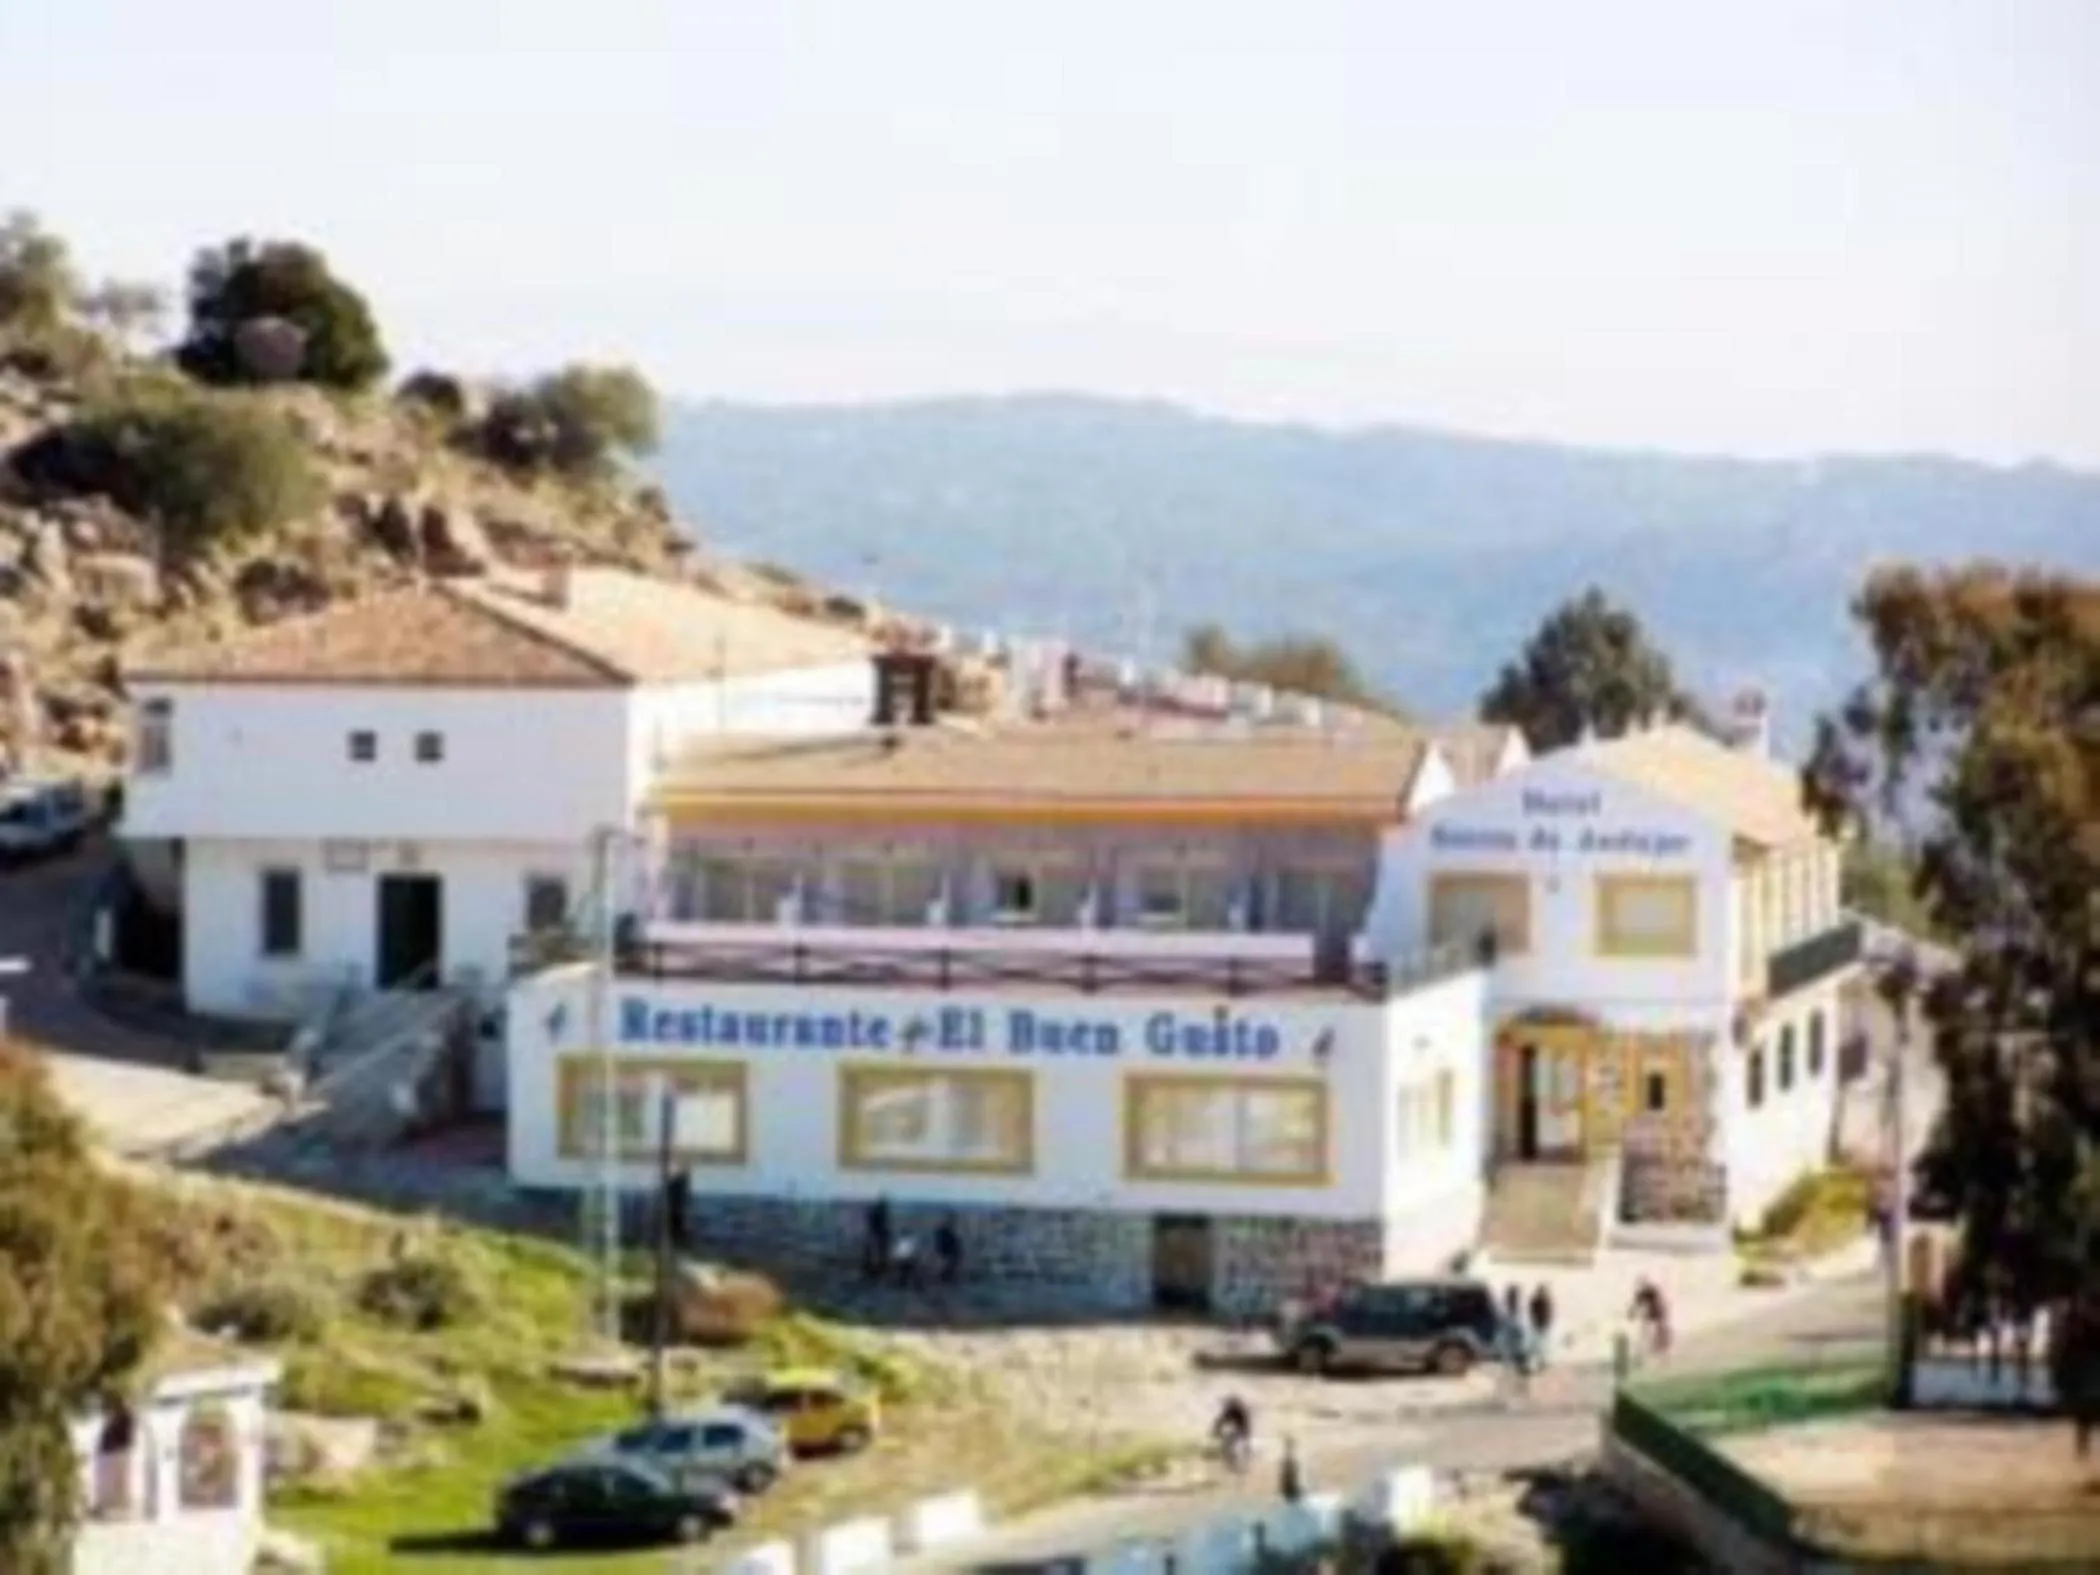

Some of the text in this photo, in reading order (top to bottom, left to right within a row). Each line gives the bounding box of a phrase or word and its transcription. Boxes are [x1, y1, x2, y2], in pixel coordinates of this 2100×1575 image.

[619, 997, 889, 1049] Restaurante
[938, 1007, 984, 1051] El
[1009, 1009, 1119, 1055] Buen
